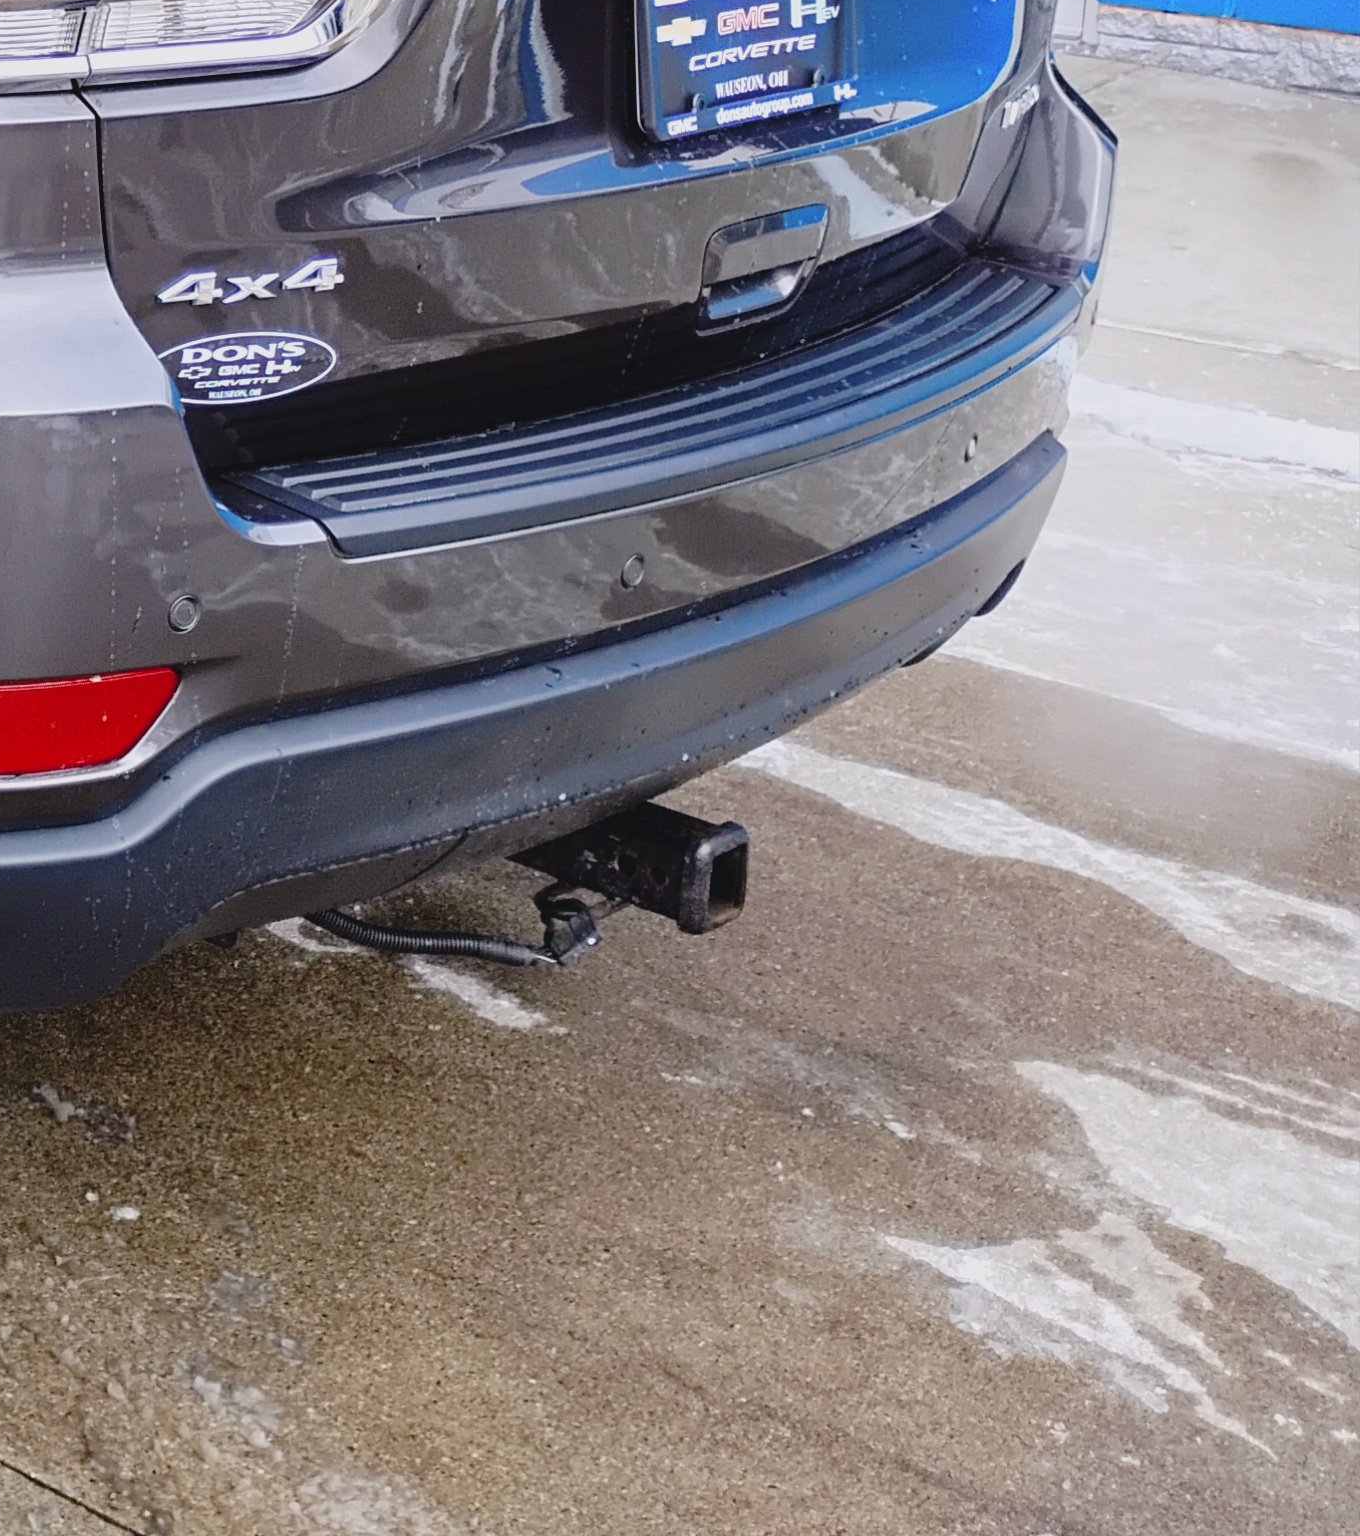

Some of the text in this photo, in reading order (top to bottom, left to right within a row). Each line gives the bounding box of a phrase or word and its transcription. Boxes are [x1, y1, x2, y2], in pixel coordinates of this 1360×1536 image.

[717, 3, 780, 36] GMC
[688, 34, 817, 72] CORVETTE
[715, 69, 789, 99] WAUSEON, OH
[716, 92, 815, 125] donsautogroup.com
[667, 115, 698, 136] GMC
[156, 257, 345, 306] 4x4
[181, 340, 306, 364] DON'S
[194, 375, 282, 390] CORVETTE
[218, 364, 260, 376] GMC
